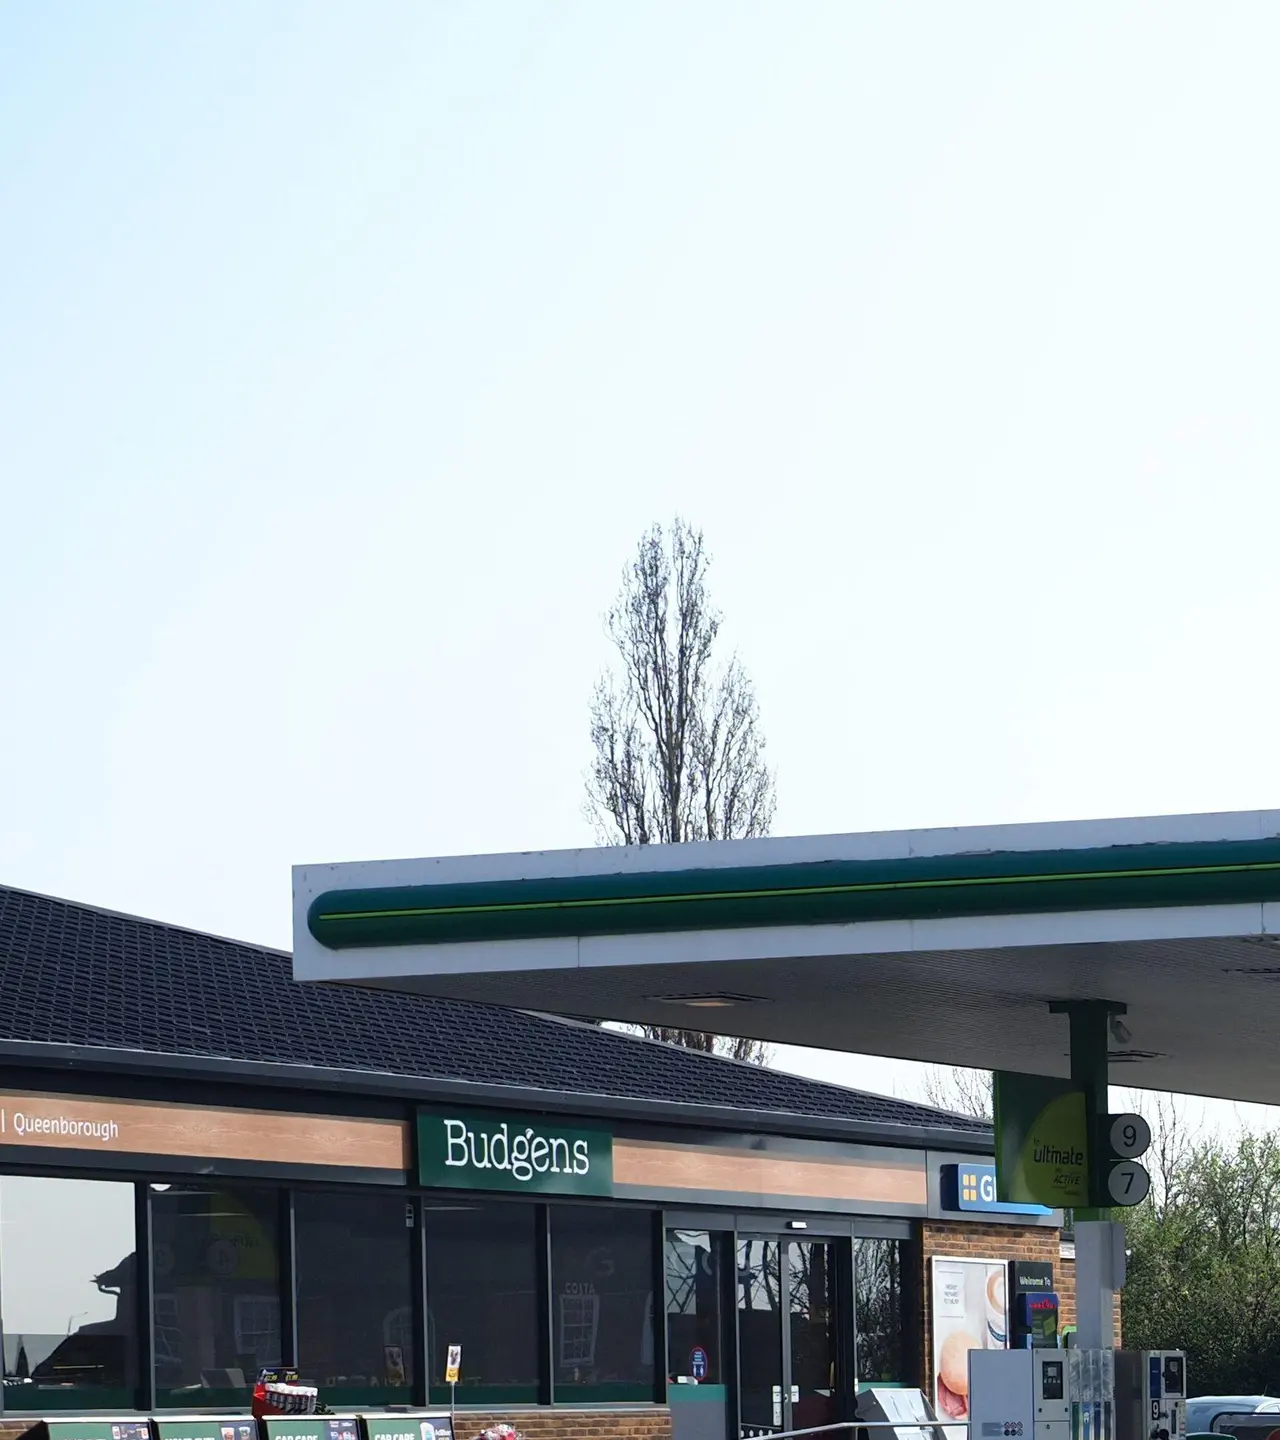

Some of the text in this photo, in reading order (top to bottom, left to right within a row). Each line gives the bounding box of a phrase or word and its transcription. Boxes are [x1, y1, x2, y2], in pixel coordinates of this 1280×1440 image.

[13, 1112, 118, 1141] Queenborough
[1122, 1125, 1137, 1147] 9
[443, 1119, 590, 1181] Budgens
[1033, 1145, 1083, 1165] ultimate
[1121, 1172, 1135, 1194] 7
[1152, 1401, 1159, 1418] 9
